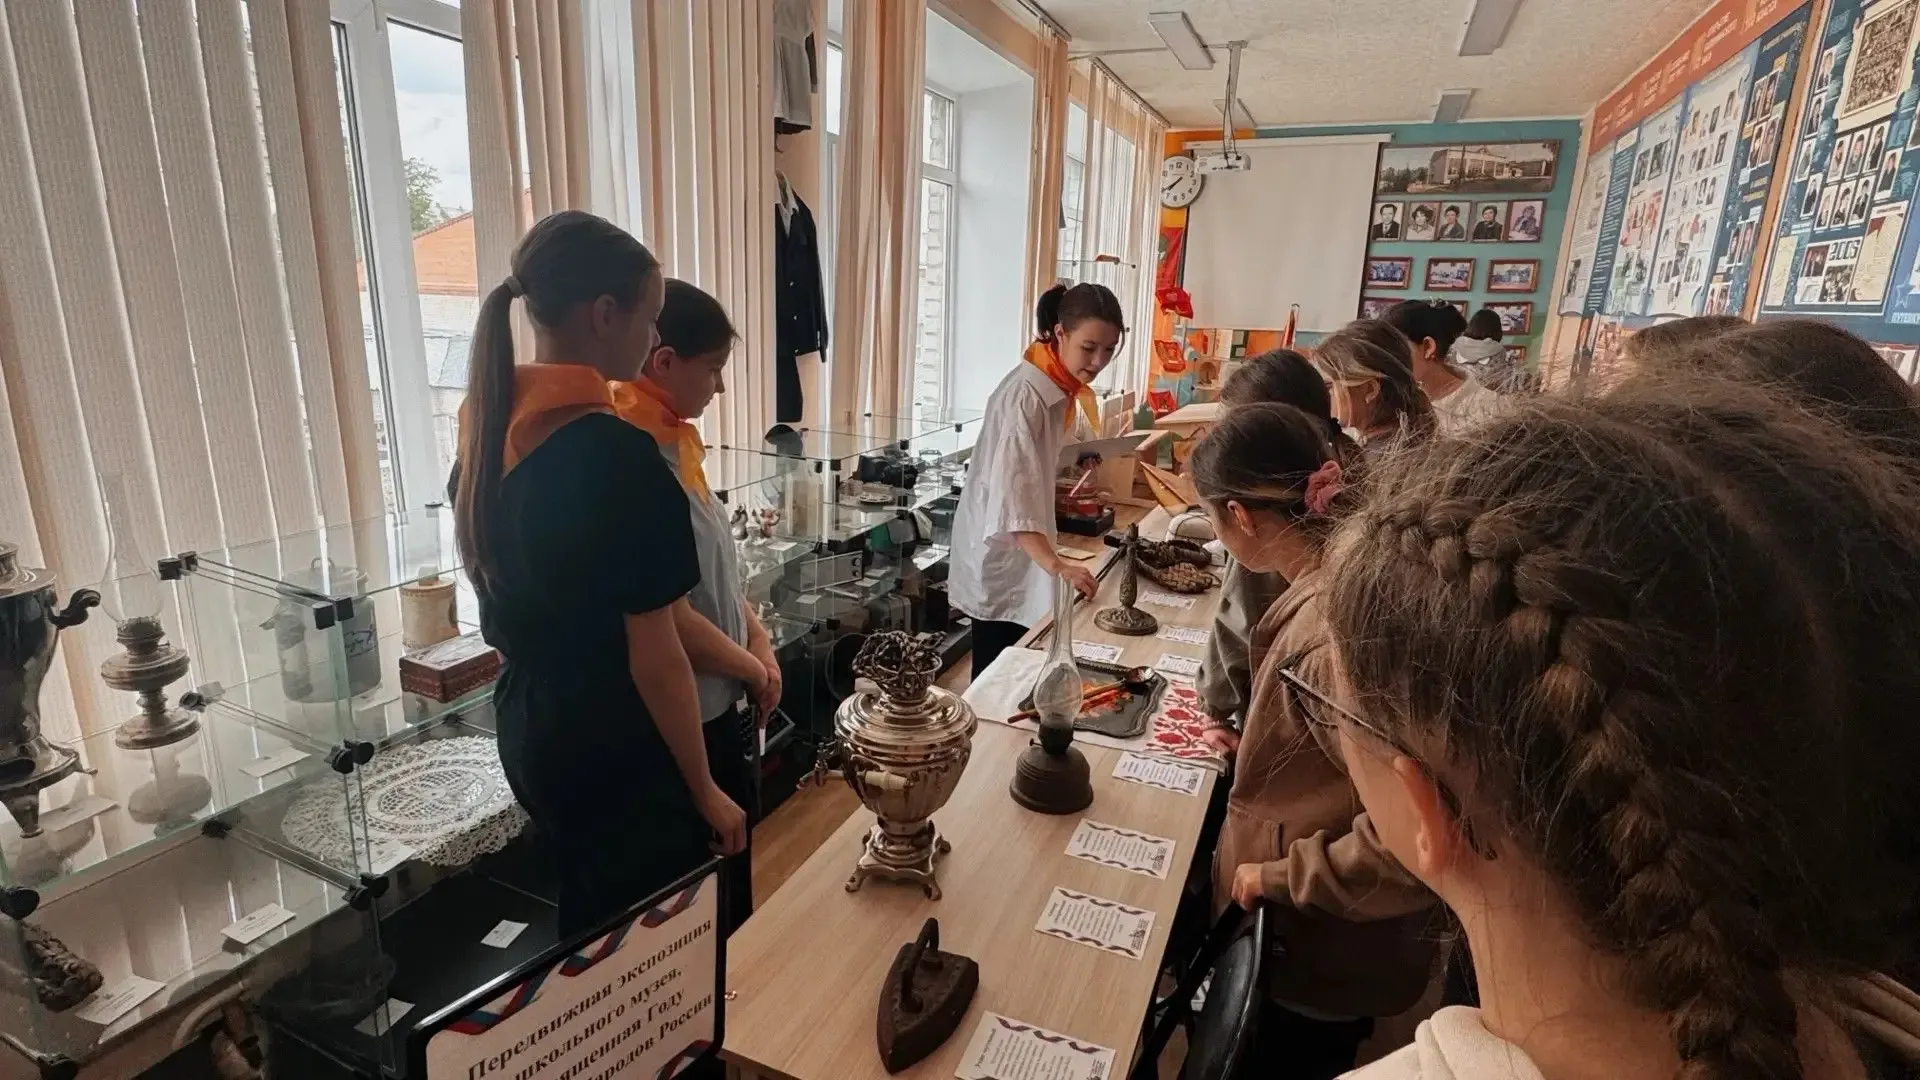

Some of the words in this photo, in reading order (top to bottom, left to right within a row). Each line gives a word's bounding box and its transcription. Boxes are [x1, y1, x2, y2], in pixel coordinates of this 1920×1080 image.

[468, 982, 613, 1080] Передвижная
[616, 918, 712, 986] экспозиция
[514, 1002, 626, 1080] школьного
[630, 967, 683, 1006] музея,
[588, 1035, 655, 1080] ародов
[659, 992, 713, 1042] России
[647, 987, 685, 1022] Году
